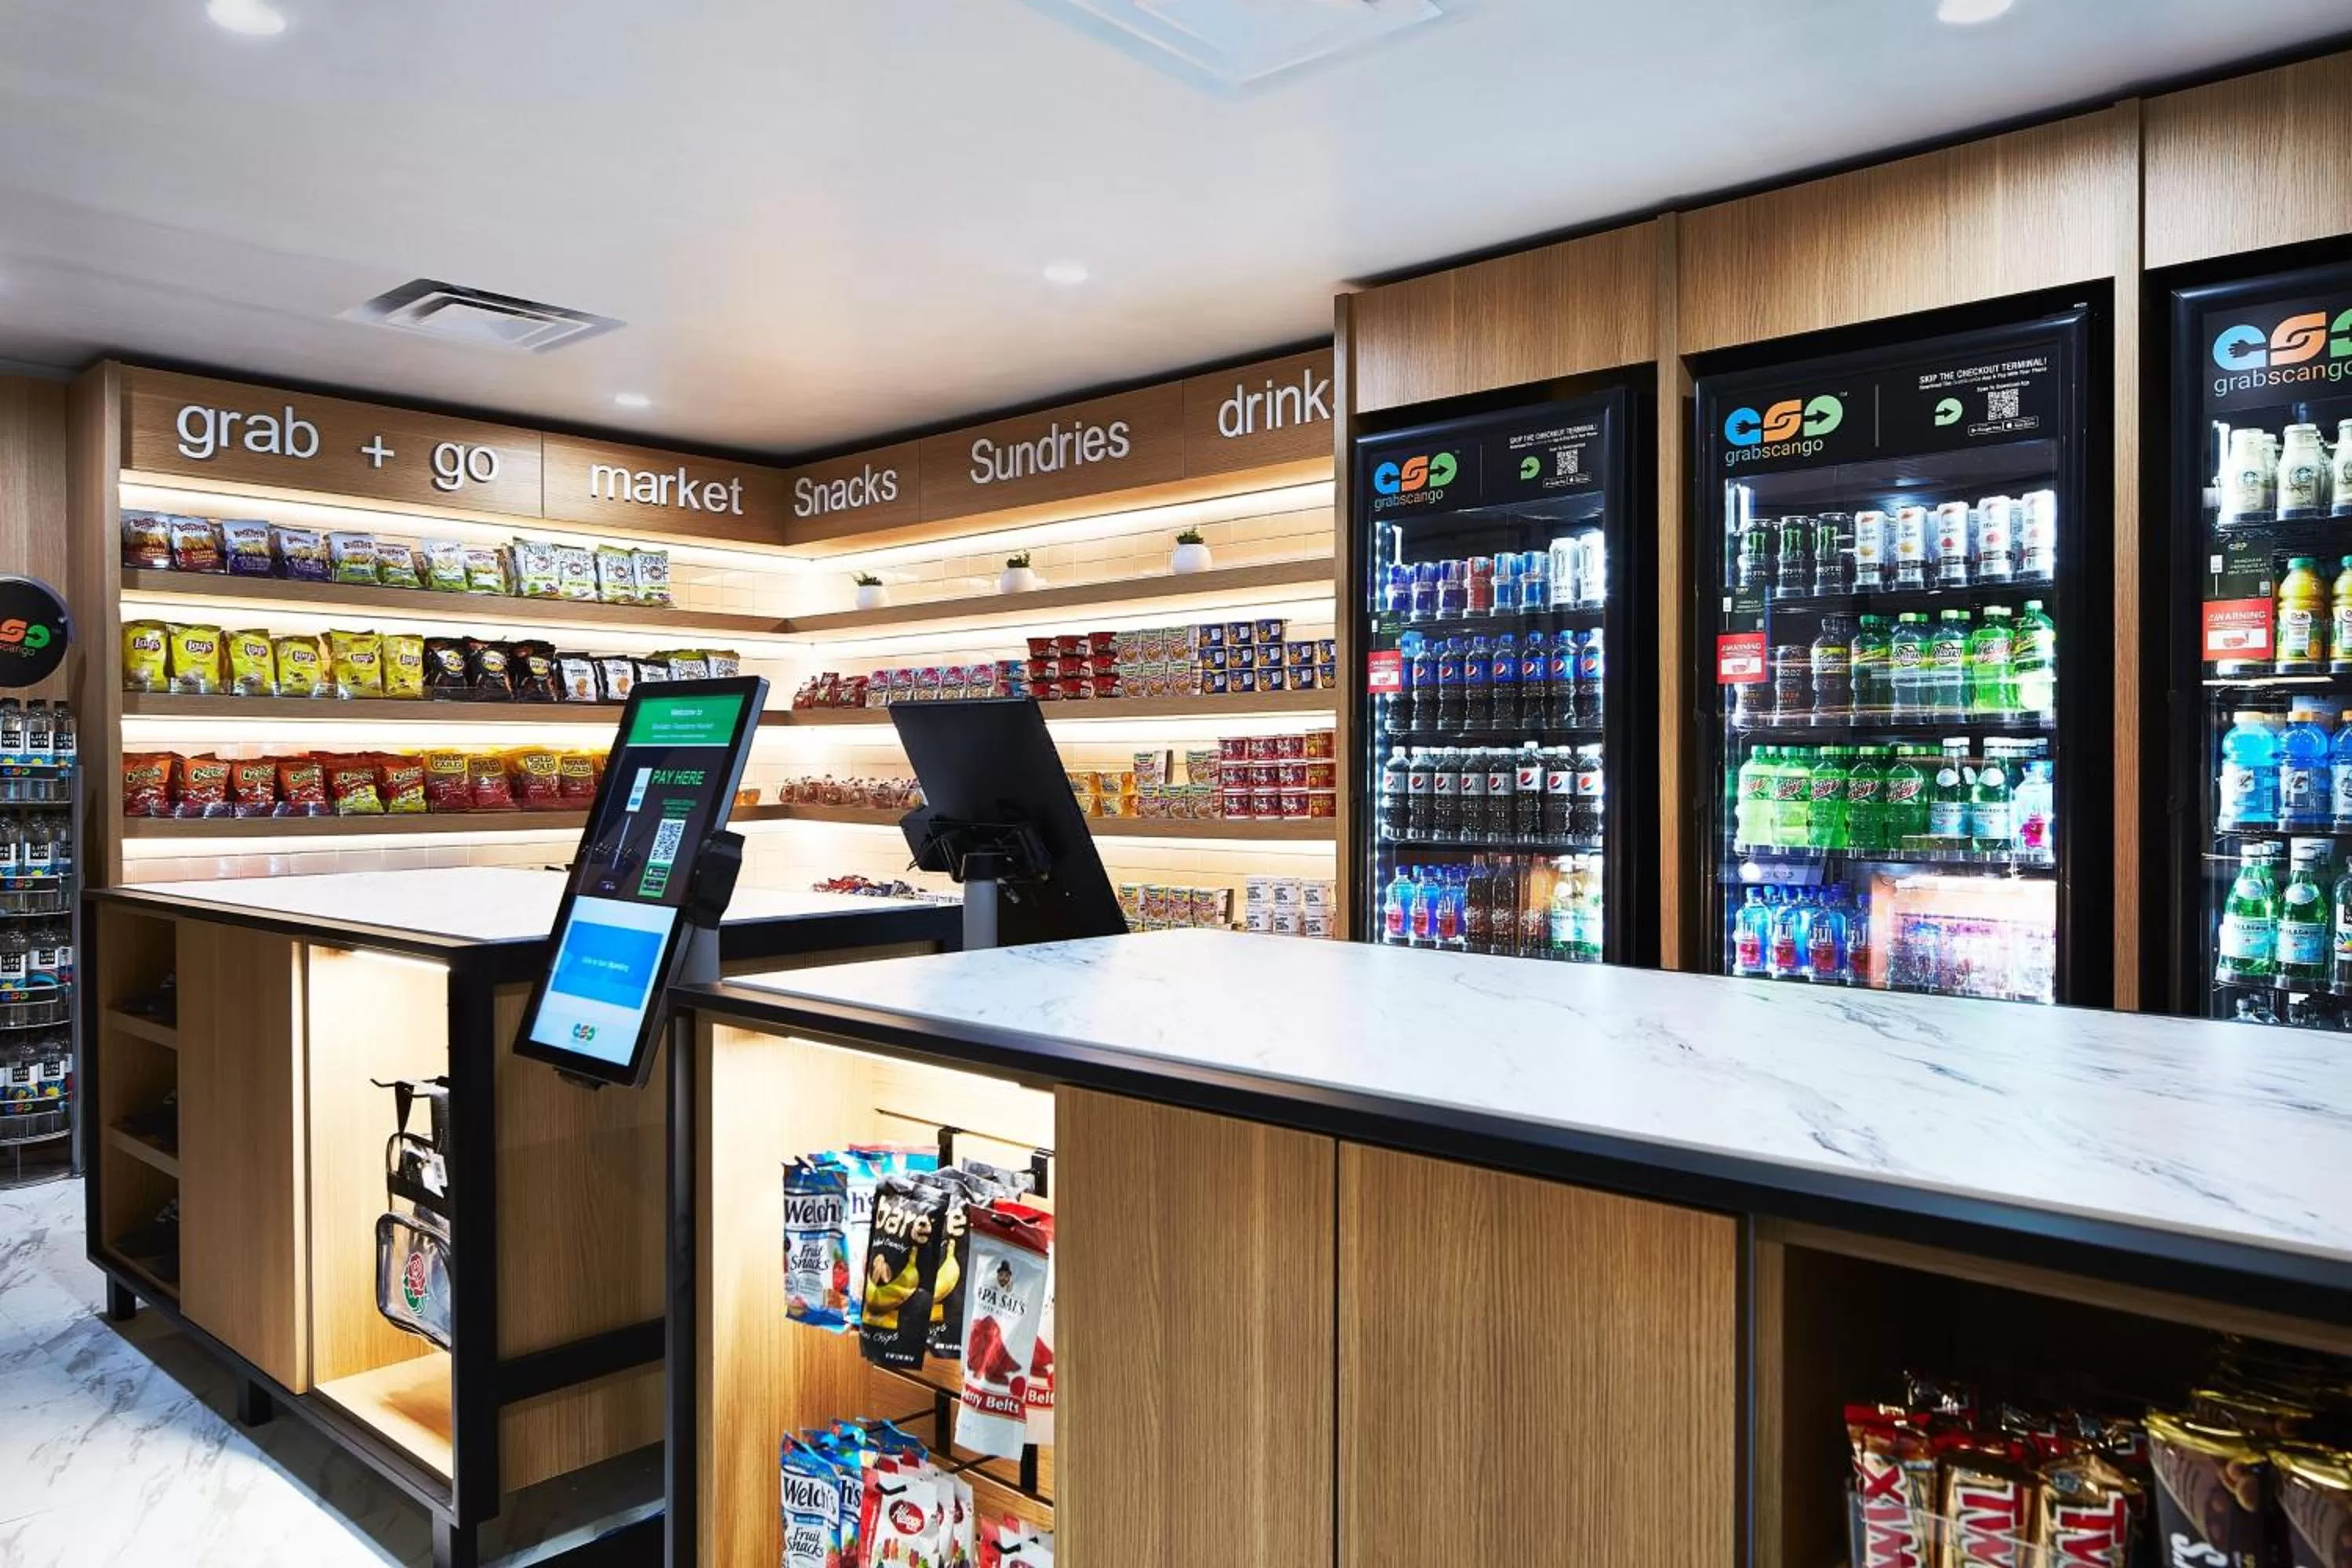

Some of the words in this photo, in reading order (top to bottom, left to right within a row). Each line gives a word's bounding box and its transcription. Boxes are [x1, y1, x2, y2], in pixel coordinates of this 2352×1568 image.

[1918, 373, 1938, 384] SKIP
[1940, 370, 1955, 381] THE
[1956, 364, 2000, 379] CHECKOUT
[2001, 357, 2048, 371] TERMINAL!
[1218, 368, 1334, 438] drink
[176, 404, 319, 459] grab
[434, 442, 499, 490] go
[970, 419, 1130, 485] Sundries
[1725, 438, 1824, 466] grabscango
[590, 461, 745, 515] market
[794, 463, 899, 518] Snacks
[1374, 488, 1443, 512] grabscango
[652, 769, 674, 785] PAY
[673, 770, 706, 786] HERE
[789, 1255, 829, 1272] Snacks
[800, 1243, 823, 1258] Fruit
[1853, 1452, 1918, 1568] WIX
[793, 1526, 822, 1543] Fruit
[1956, 1481, 2027, 1568] TW
[786, 1537, 825, 1558] Snacks
